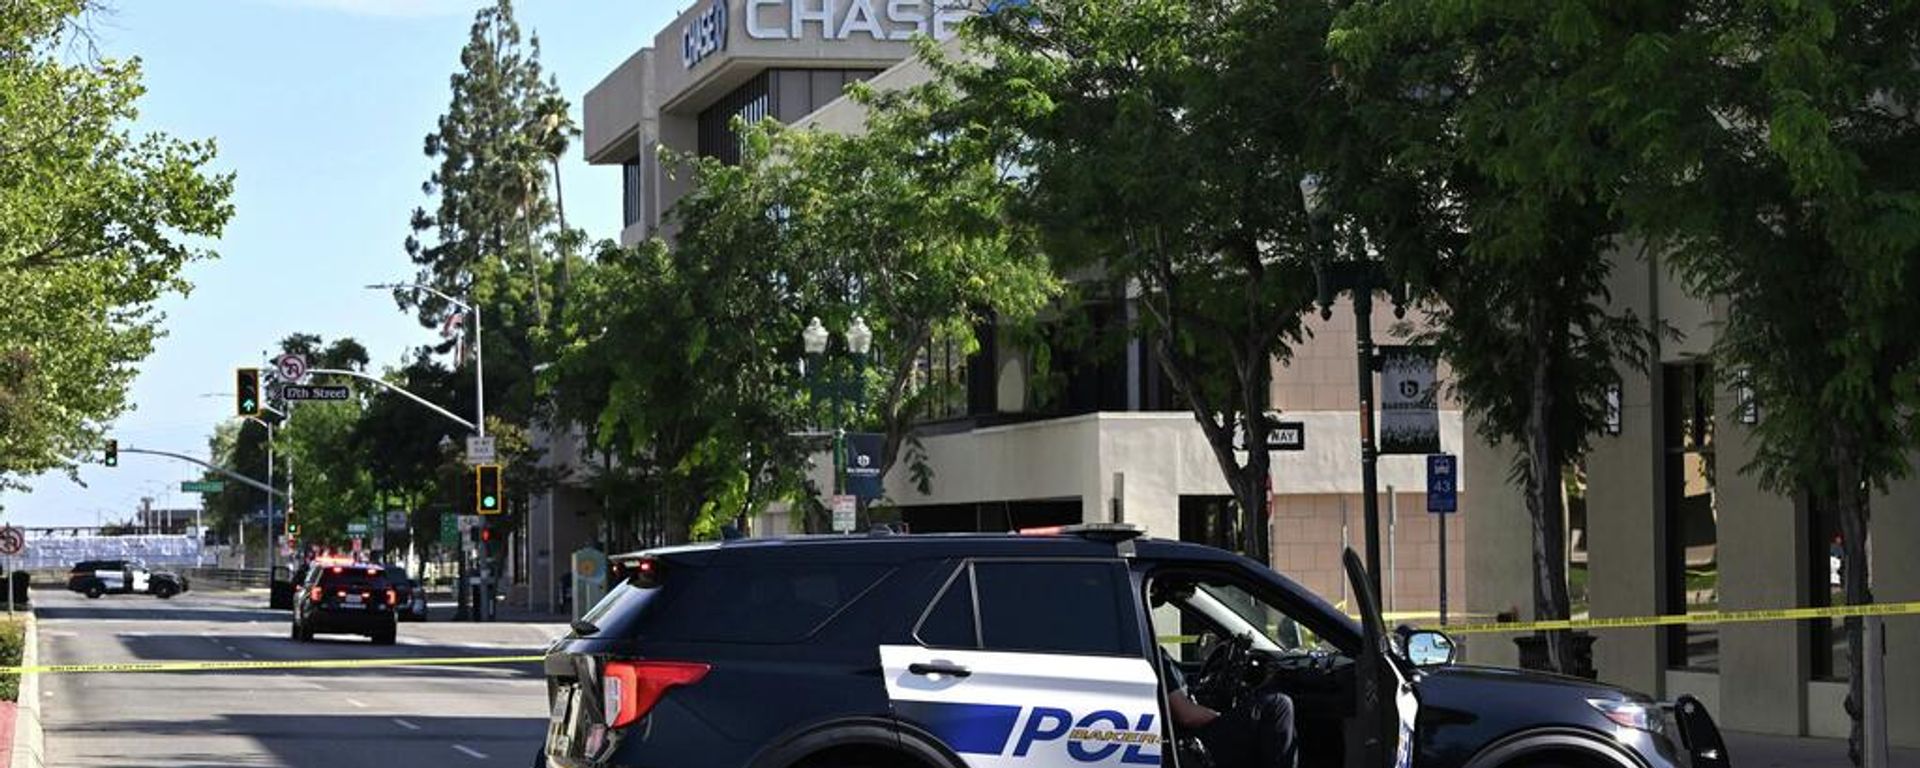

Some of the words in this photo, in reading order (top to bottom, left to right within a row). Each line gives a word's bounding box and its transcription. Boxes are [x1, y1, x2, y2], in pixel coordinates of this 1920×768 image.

[746, 0, 970, 41] CHASE
[682, 5, 717, 69] CHASE
[287, 387, 309, 399] 17th
[313, 387, 346, 398] Street
[1433, 480, 1451, 493] 43
